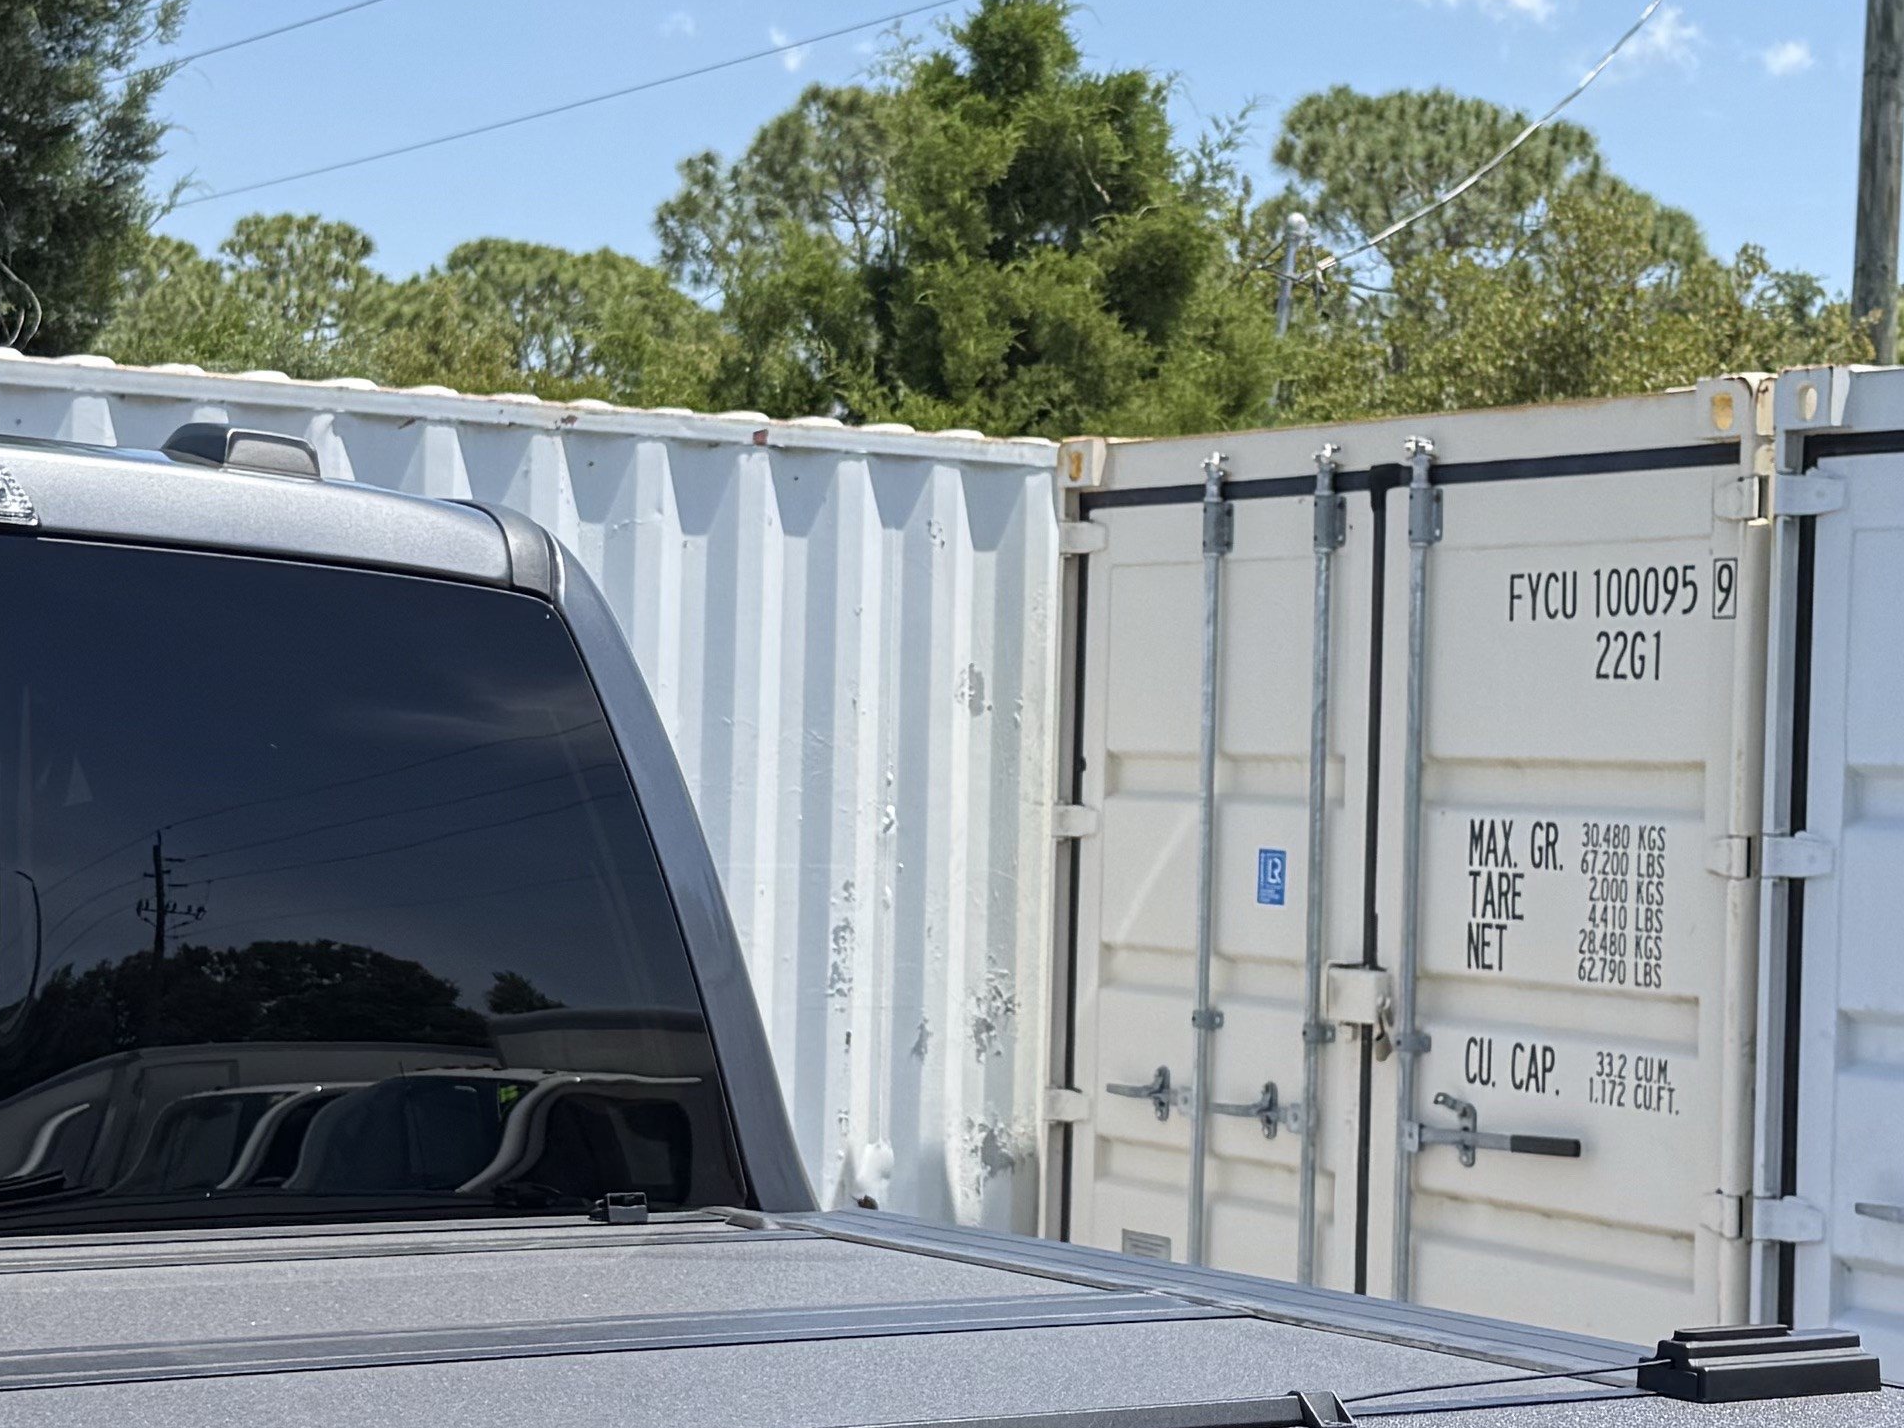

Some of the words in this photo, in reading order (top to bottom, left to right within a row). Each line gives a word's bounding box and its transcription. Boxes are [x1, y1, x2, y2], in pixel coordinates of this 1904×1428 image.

[1508, 570, 1578, 622] FYCU
[1593, 564, 1698, 618] 100095
[1716, 562, 1735, 615] 9
[1596, 630, 1662, 680] 22G1
[1469, 819, 1518, 869] MAX.
[1530, 821, 1564, 871] GR.
[1581, 823, 1630, 850] 30.480
[1638, 826, 1666, 852] KGS
[1580, 850, 1629, 876] 67.200
[1636, 853, 1666, 879] LBS
[1469, 870, 1524, 921] TARE
[1588, 876, 1628, 904] 2.000
[1636, 880, 1664, 906] KGS
[1588, 904, 1628, 930] 4.410
[1635, 908, 1664, 934] LBS
[1467, 922, 1508, 972] NET
[1578, 929, 1626, 957] 28.480
[1634, 935, 1662, 961] KGS
[1578, 957, 1626, 985] 62.790
[1634, 962, 1662, 988] LBS
[1465, 1036, 1496, 1088] CU.
[1510, 1042, 1560, 1096] CAP.
[1596, 1051, 1626, 1080] 33.2
[1588, 1078, 1626, 1108] 1.172
